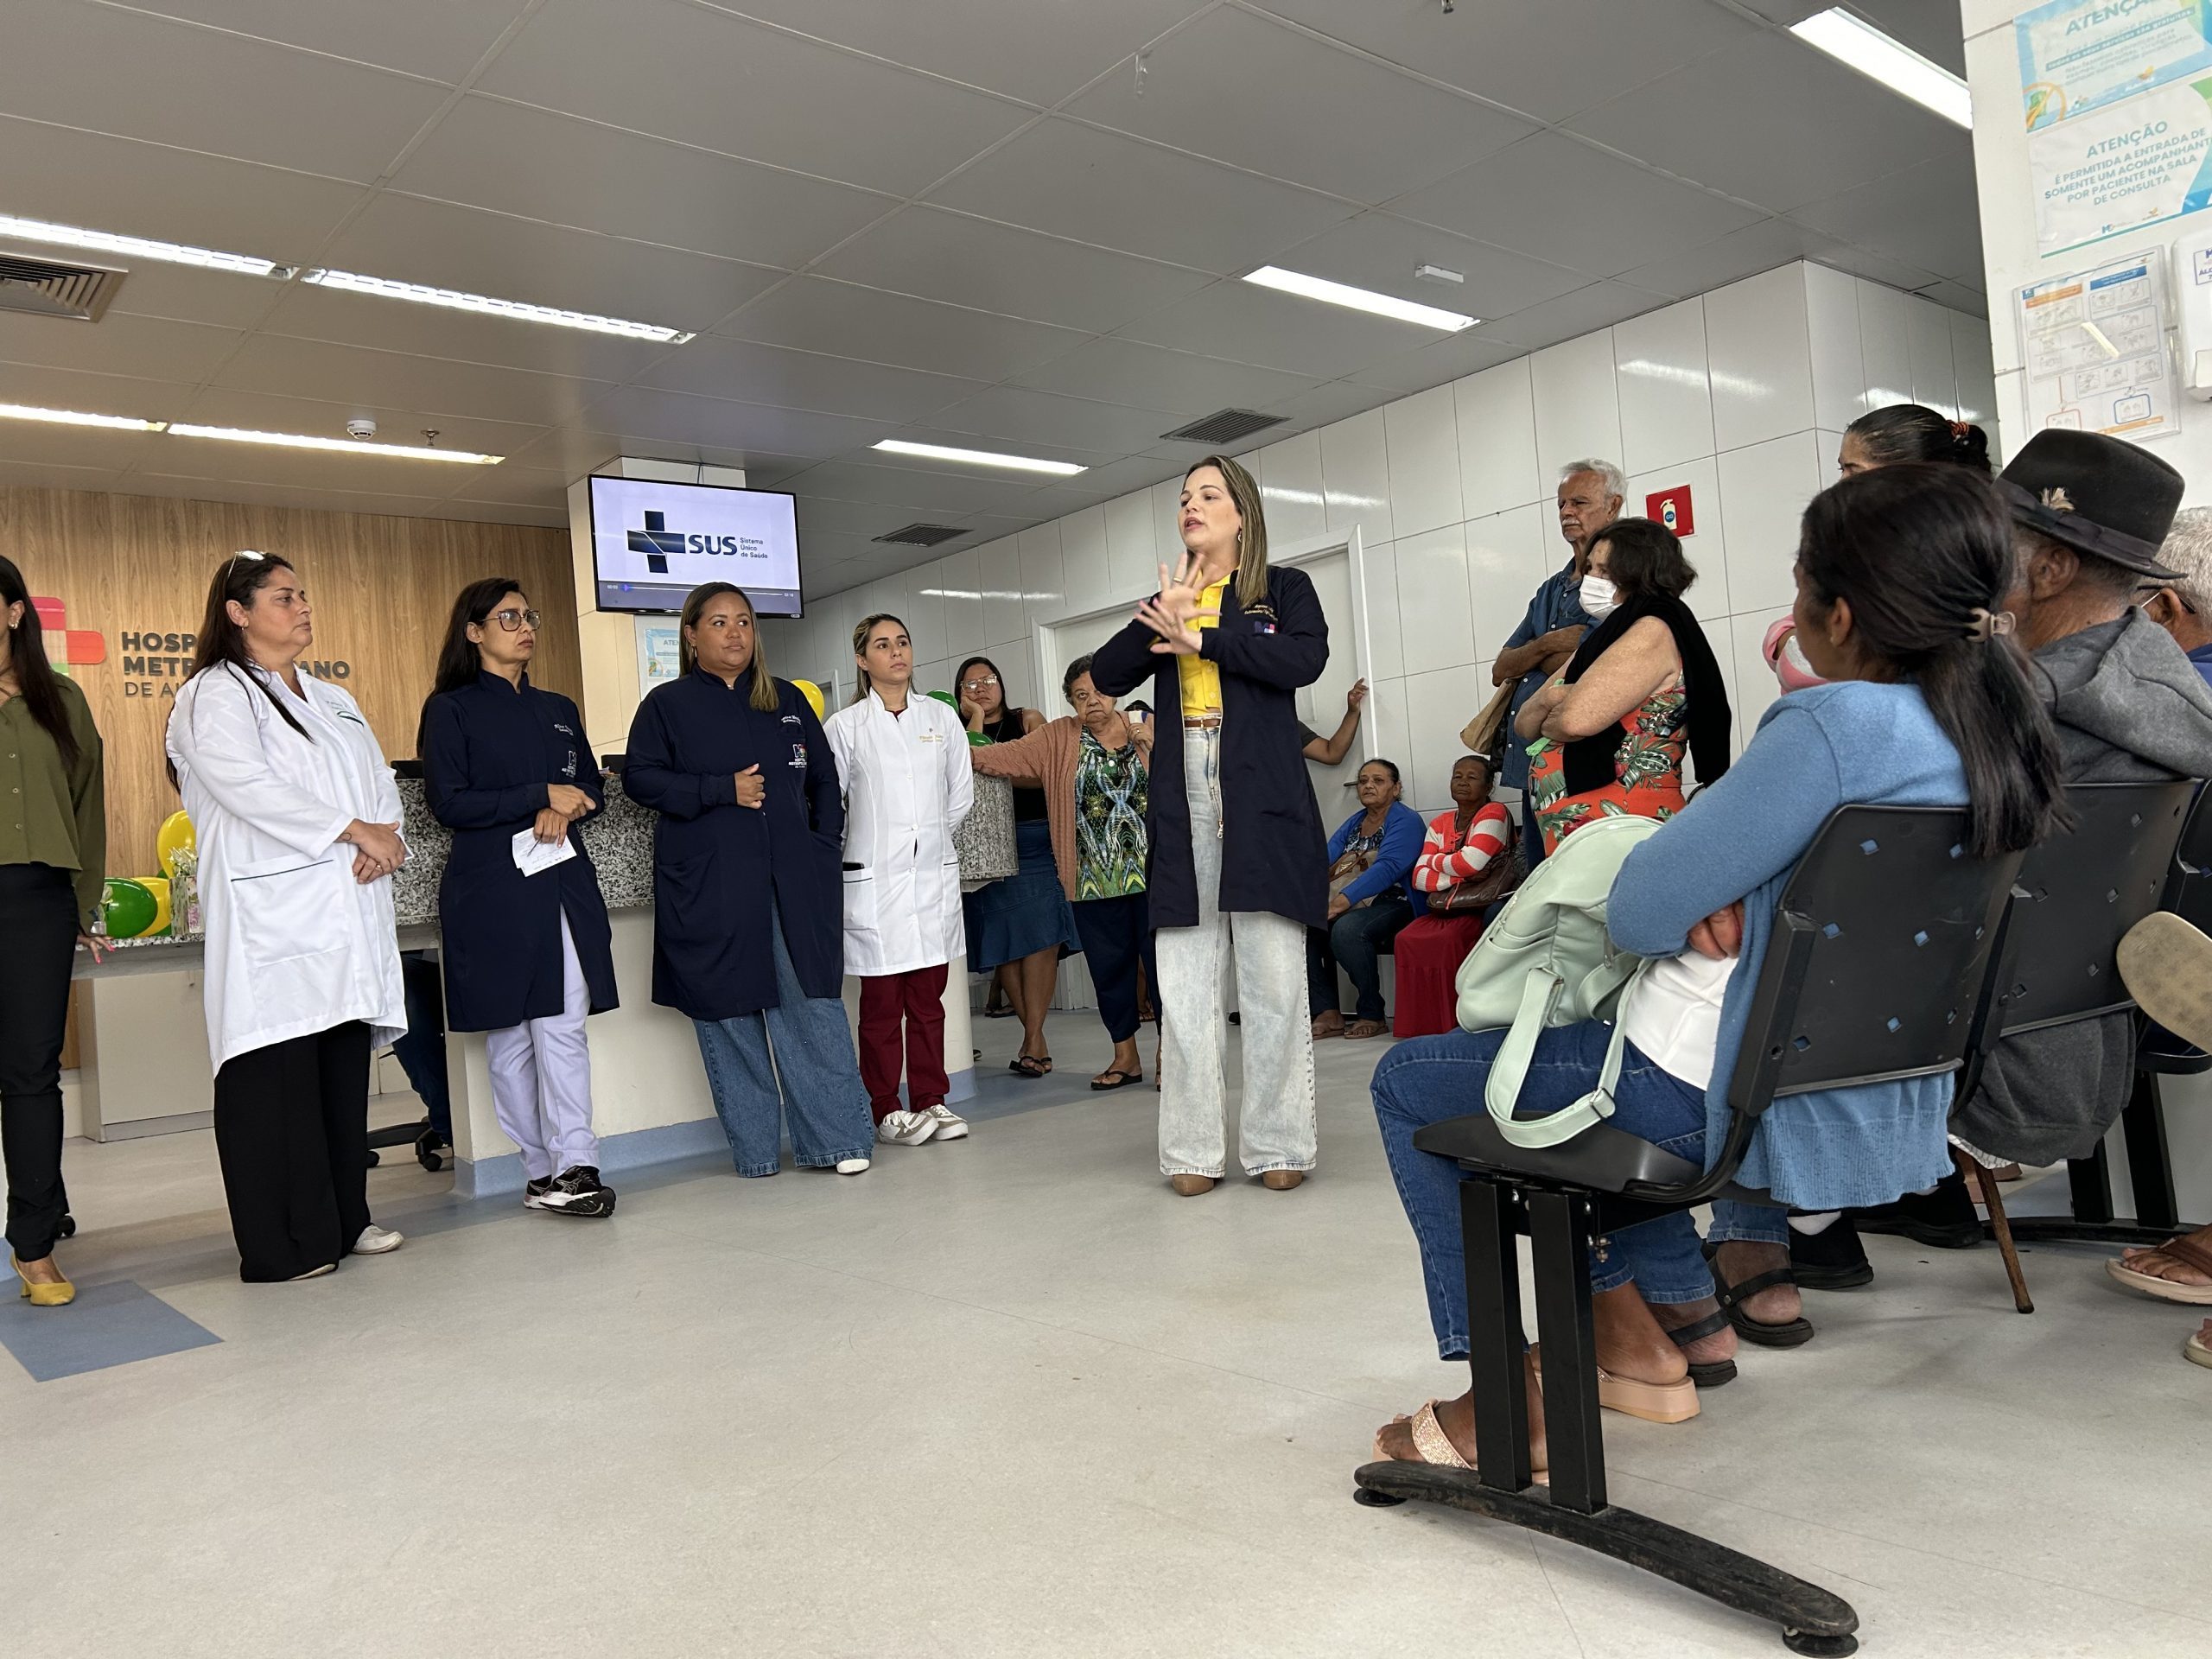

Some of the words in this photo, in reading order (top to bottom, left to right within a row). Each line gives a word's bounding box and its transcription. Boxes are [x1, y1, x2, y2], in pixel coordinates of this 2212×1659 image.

[2066, 0, 2149, 35] ATENÇ
[2055, 173, 2062, 185] É
[2063, 156, 2121, 181] PERMITIDA
[2134, 134, 2189, 158] ENTRADA
[2191, 128, 2206, 139] DE
[2087, 121, 2168, 158] ATENÇÃO
[2044, 175, 2096, 199] SOMENTE
[2098, 168, 2116, 181] UM
[2119, 137, 2212, 175] ACOMPANHANT
[2068, 188, 2089, 203] POR
[2092, 172, 2145, 194] PACIENTE
[2148, 164, 2165, 177] NA
[2166, 155, 2197, 170] SALA
[2094, 194, 2107, 206] DE
[2109, 175, 2171, 200] CONSULTA
[688, 534, 738, 556] SUS
[122, 632, 198, 652] HOSP
[125, 682, 153, 697] DE
